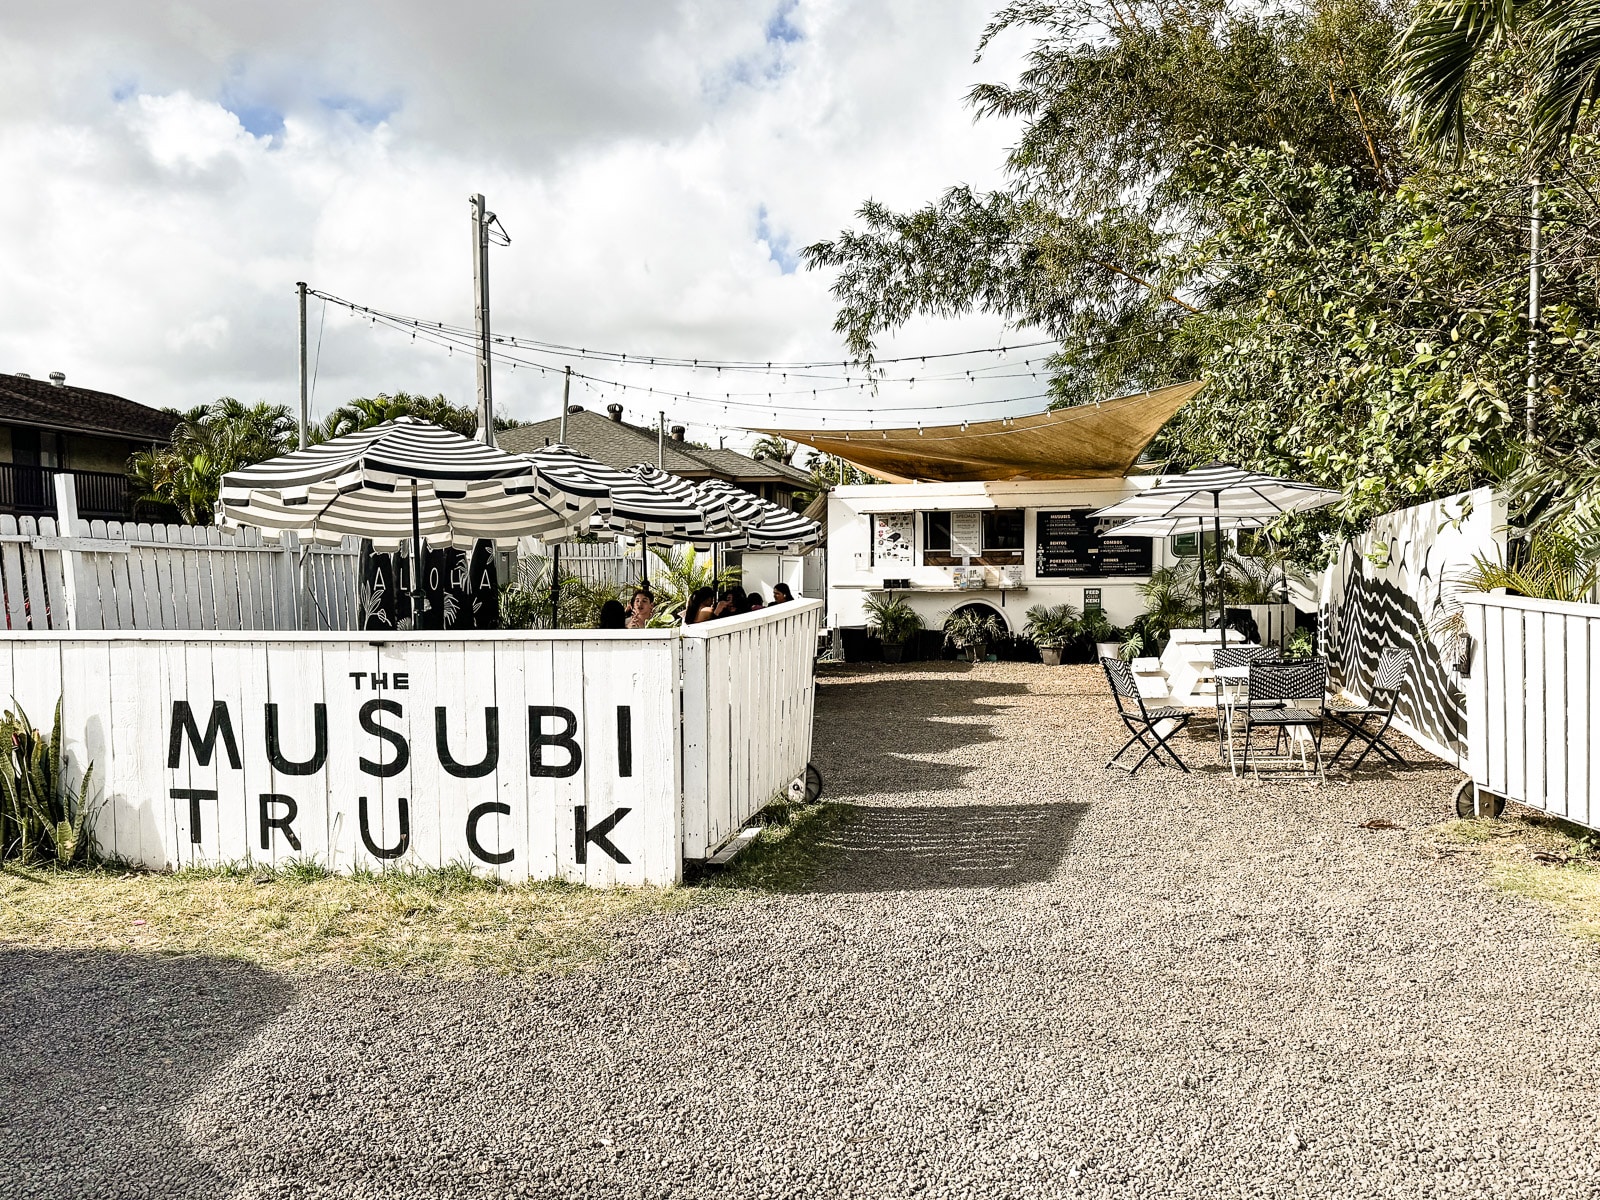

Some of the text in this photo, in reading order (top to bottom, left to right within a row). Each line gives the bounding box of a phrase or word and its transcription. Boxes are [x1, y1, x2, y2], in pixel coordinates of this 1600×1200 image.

[373, 566, 492, 591] ALOHA
[349, 671, 410, 690] THE
[167, 698, 633, 779] MUSUBI
[169, 788, 632, 866] TRUCK
